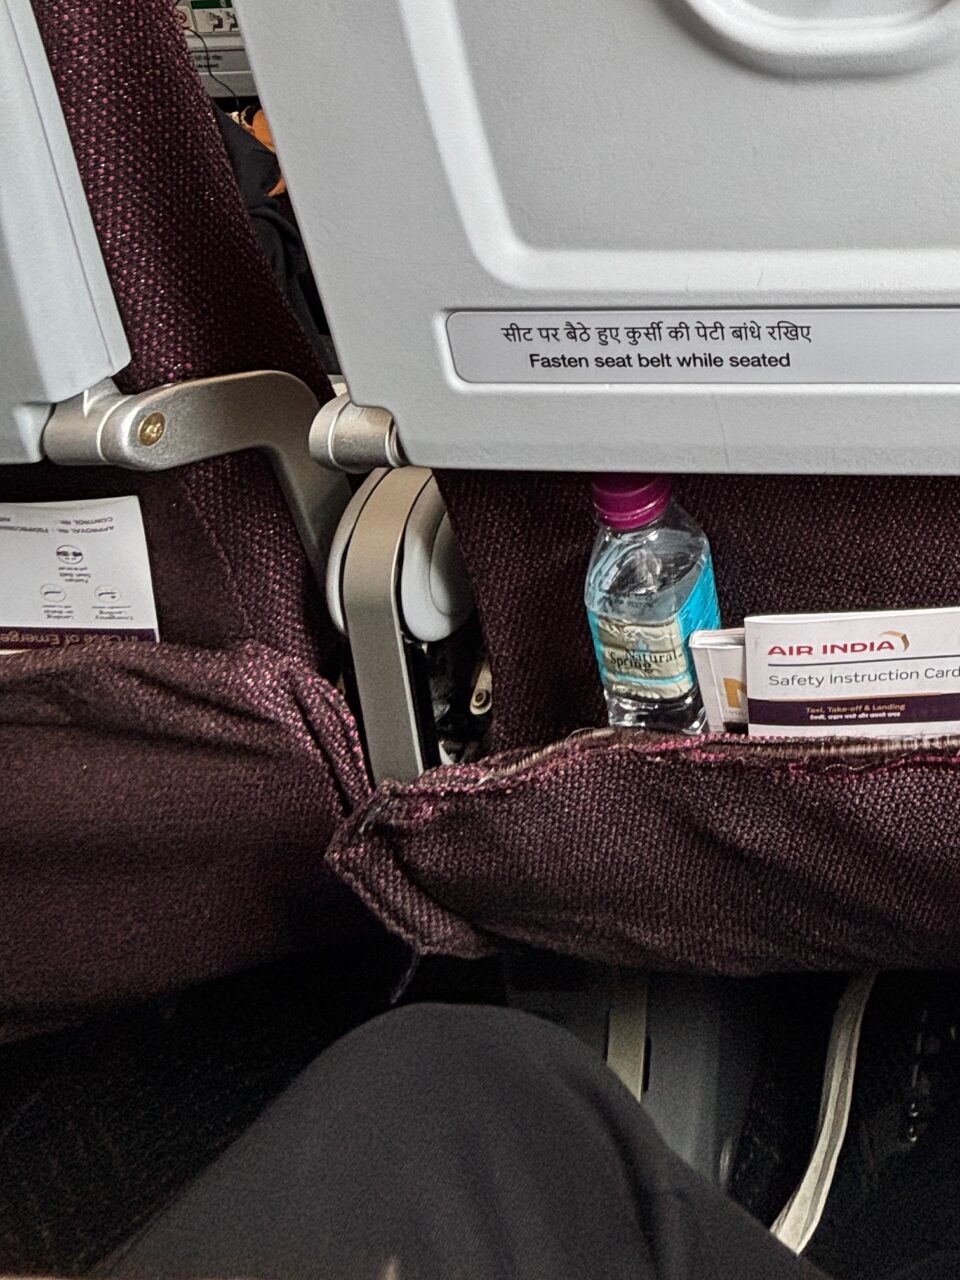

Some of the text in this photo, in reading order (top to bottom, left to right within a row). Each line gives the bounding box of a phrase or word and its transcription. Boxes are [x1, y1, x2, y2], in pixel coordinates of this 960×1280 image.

[501, 320, 812, 346] सीट पर बैठे हुए कुर्सी की पेटी बांधे रखिए
[529, 352, 791, 368] Fasten seat belt while seated
[768, 640, 895, 656] AIR INDIA
[768, 674, 824, 688] Safety
[829, 668, 920, 685] Instruction
[872, 702, 906, 712] Landing
